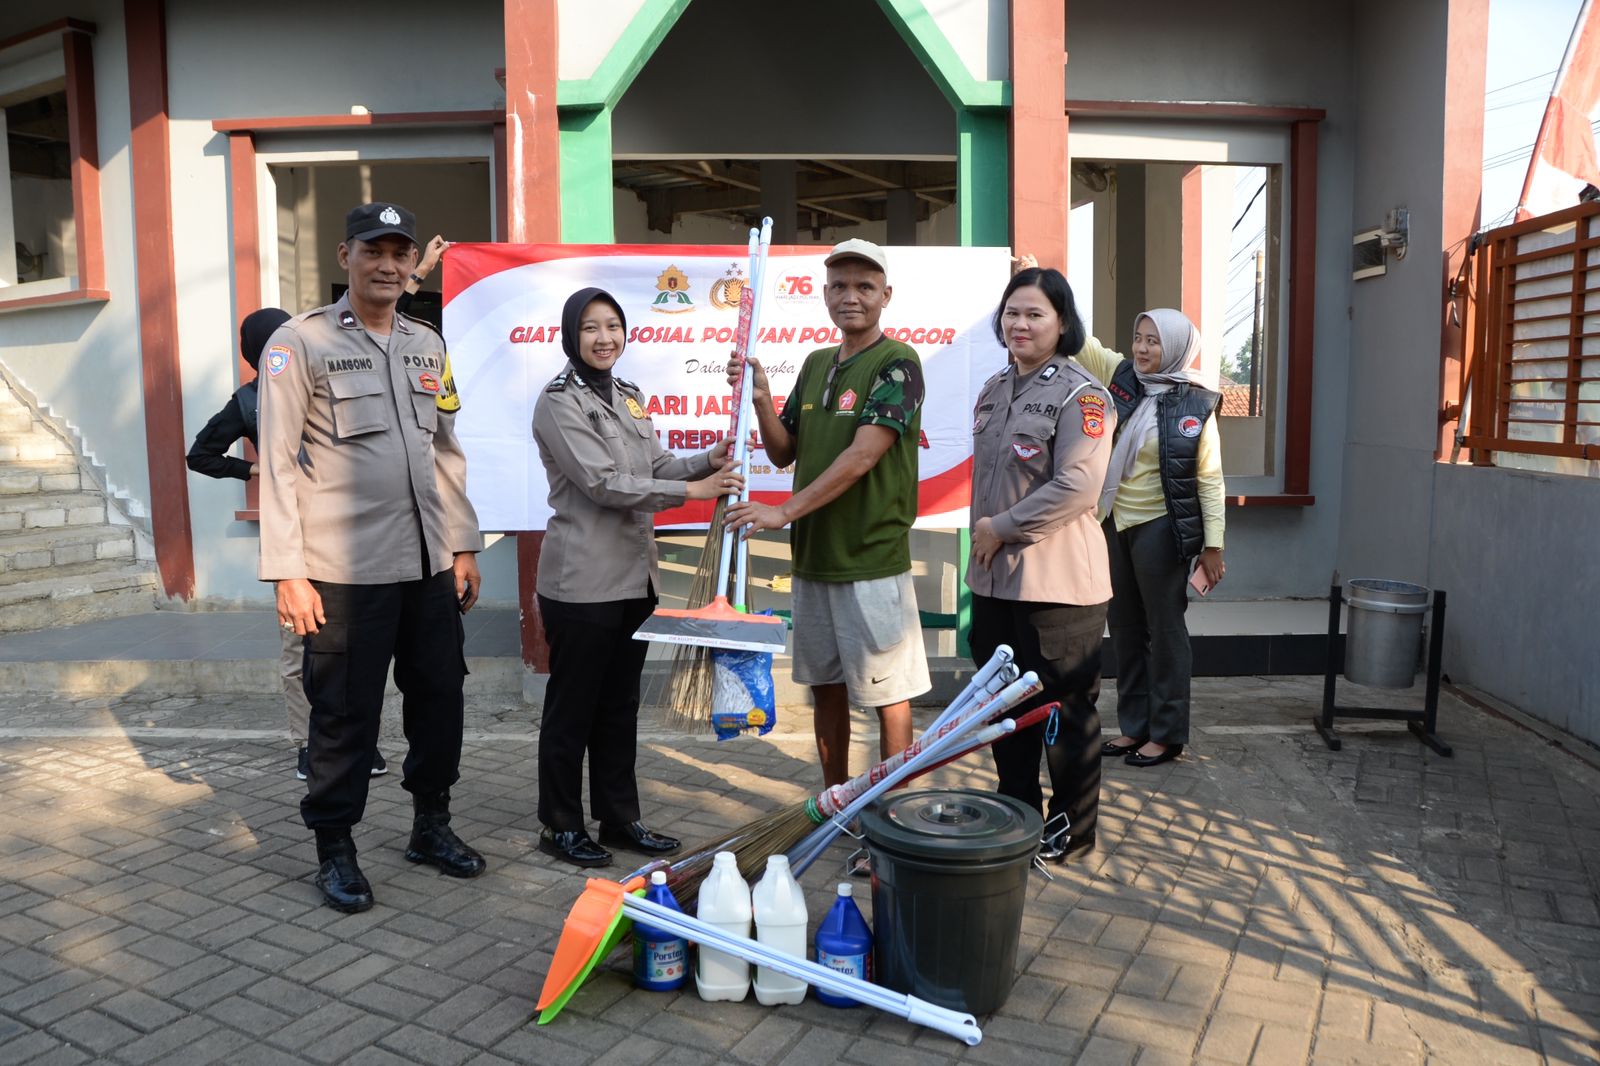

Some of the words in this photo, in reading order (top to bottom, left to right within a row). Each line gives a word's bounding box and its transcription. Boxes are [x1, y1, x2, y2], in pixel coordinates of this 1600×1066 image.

[785, 275, 813, 295] 76
[509, 326, 561, 343] GIAT
[628, 326, 695, 343] SOSIAL
[327, 358, 373, 373] MARGONO
[403, 355, 439, 370] POLRI
[647, 395, 688, 415] ARI
[1023, 402, 1058, 417] POLRI
